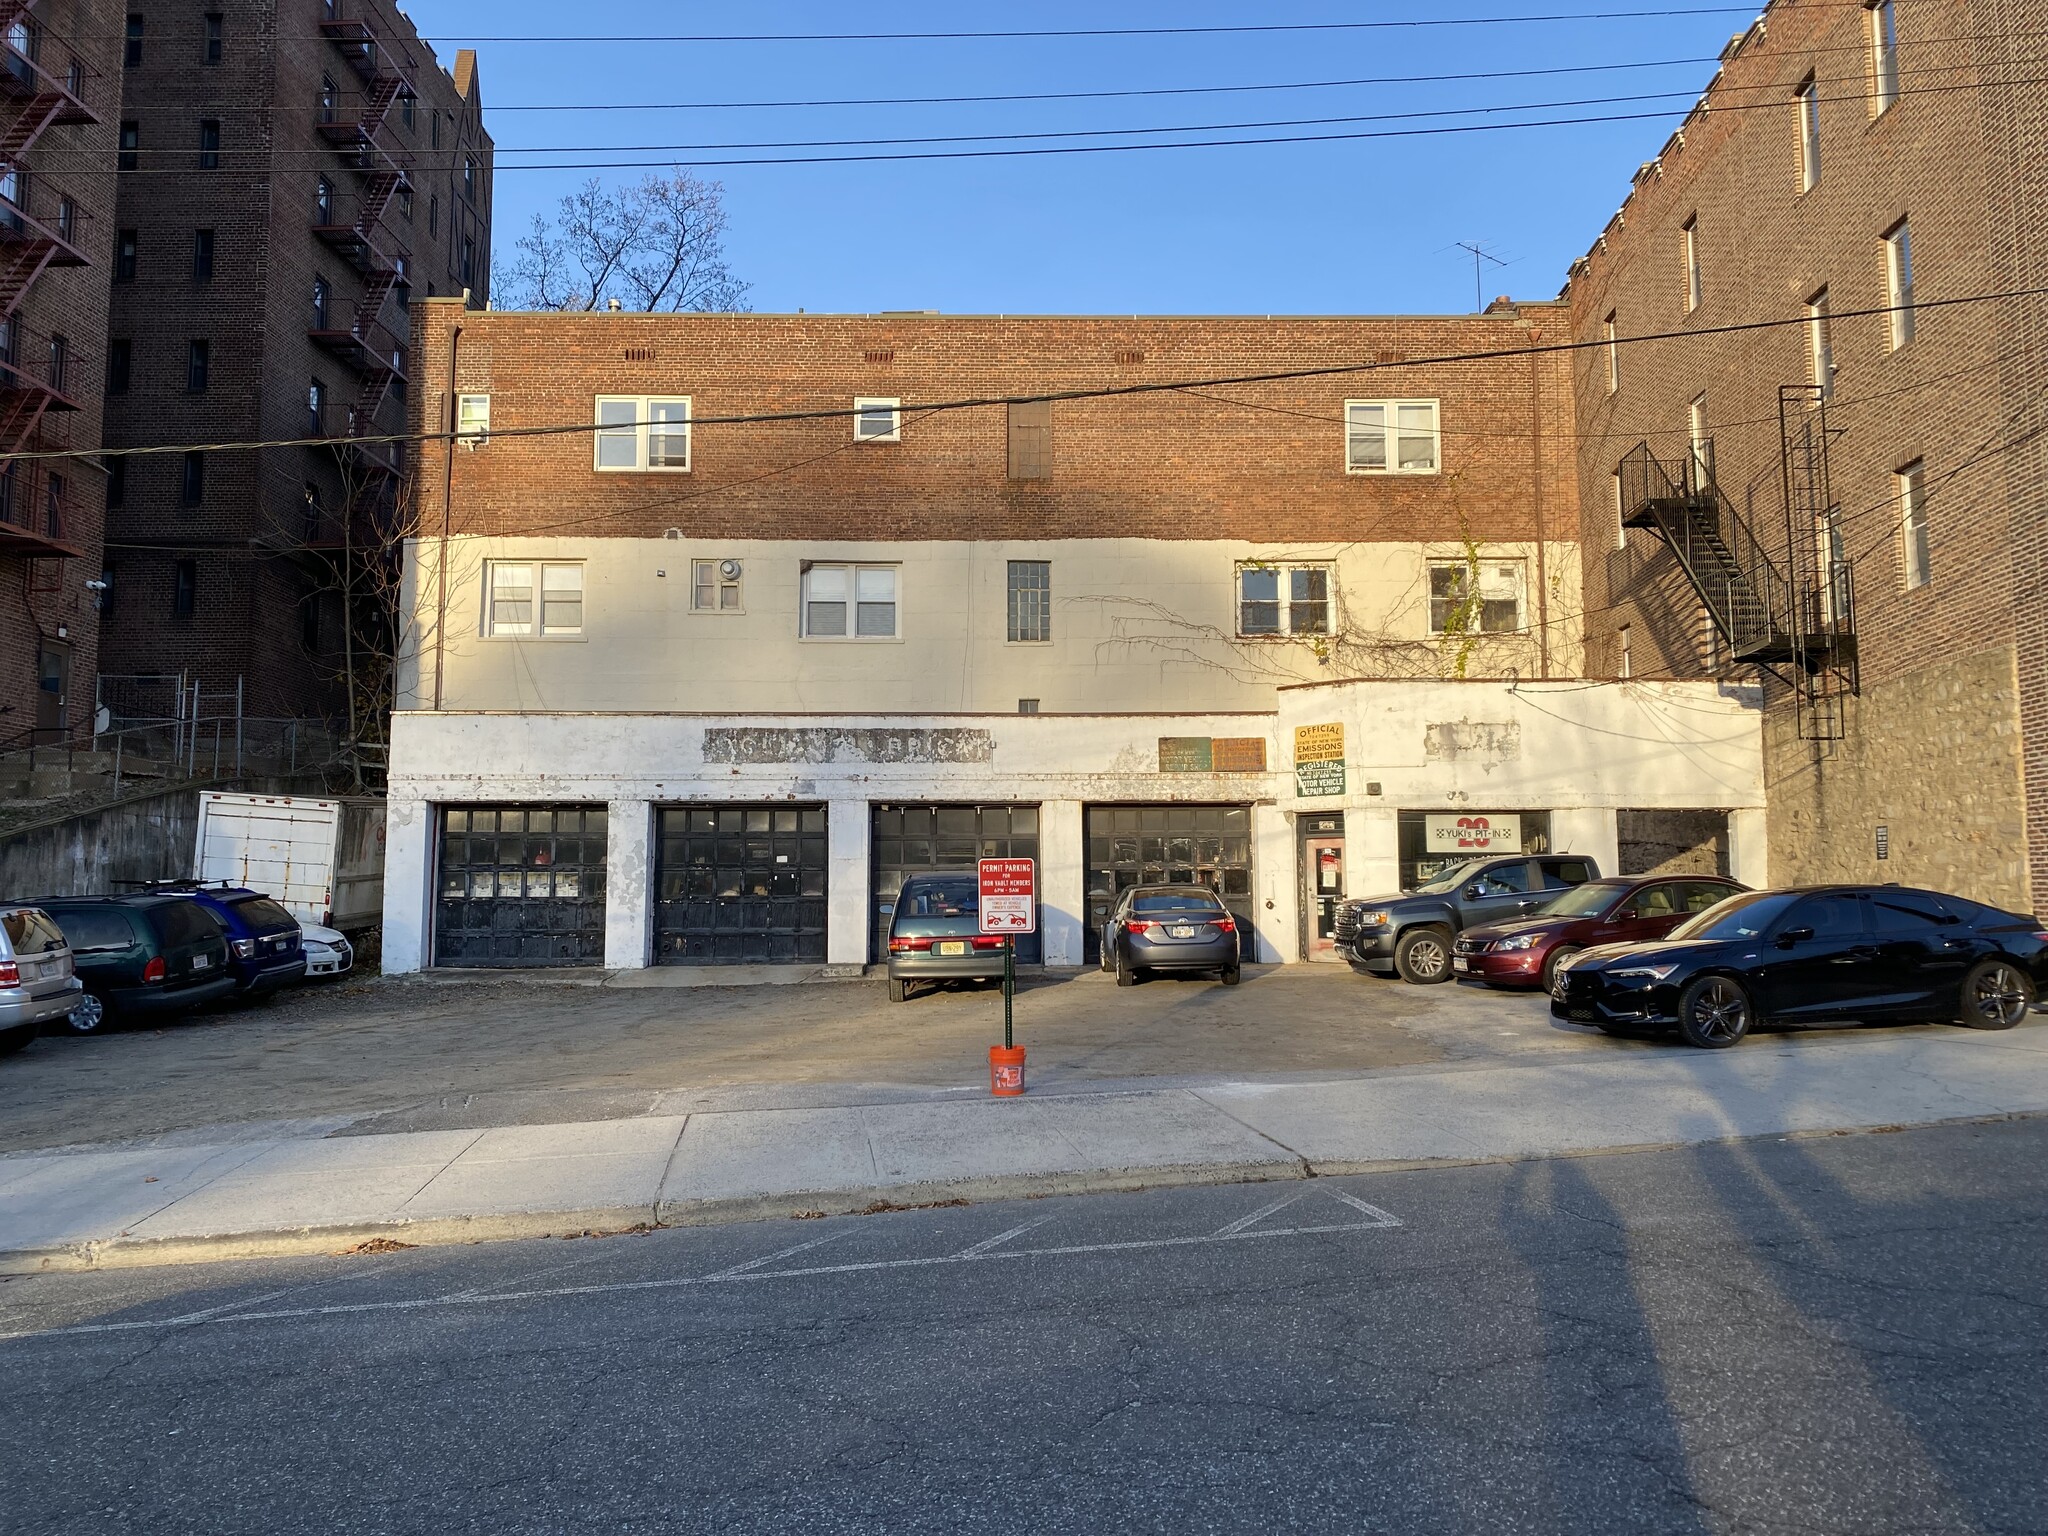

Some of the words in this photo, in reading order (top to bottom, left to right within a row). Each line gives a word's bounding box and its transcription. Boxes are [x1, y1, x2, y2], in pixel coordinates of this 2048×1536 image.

[1300, 725, 1339, 737] OFFICIAL
[1298, 742, 1342, 752] EMISSIONS
[1319, 778, 1344, 786] VEHICLE
[1324, 786, 1341, 794] SHOP
[1446, 830, 1472, 838] YUKI's
